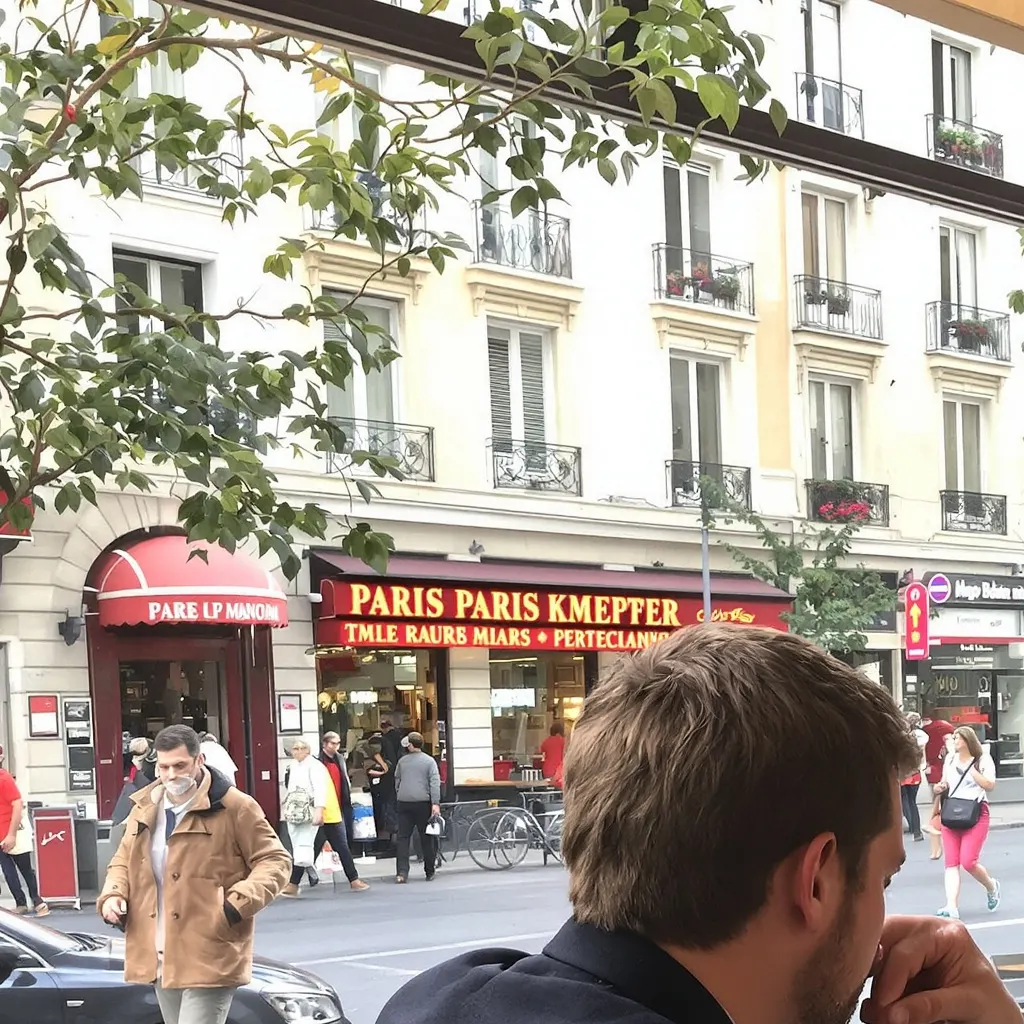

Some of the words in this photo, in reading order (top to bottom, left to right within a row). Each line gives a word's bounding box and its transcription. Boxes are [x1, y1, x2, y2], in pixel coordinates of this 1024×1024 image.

[148, 602, 199, 620] PARE
[350, 584, 444, 618] PARIS
[455, 589, 540, 621] PARIS
[344, 623, 399, 643] TMLE
